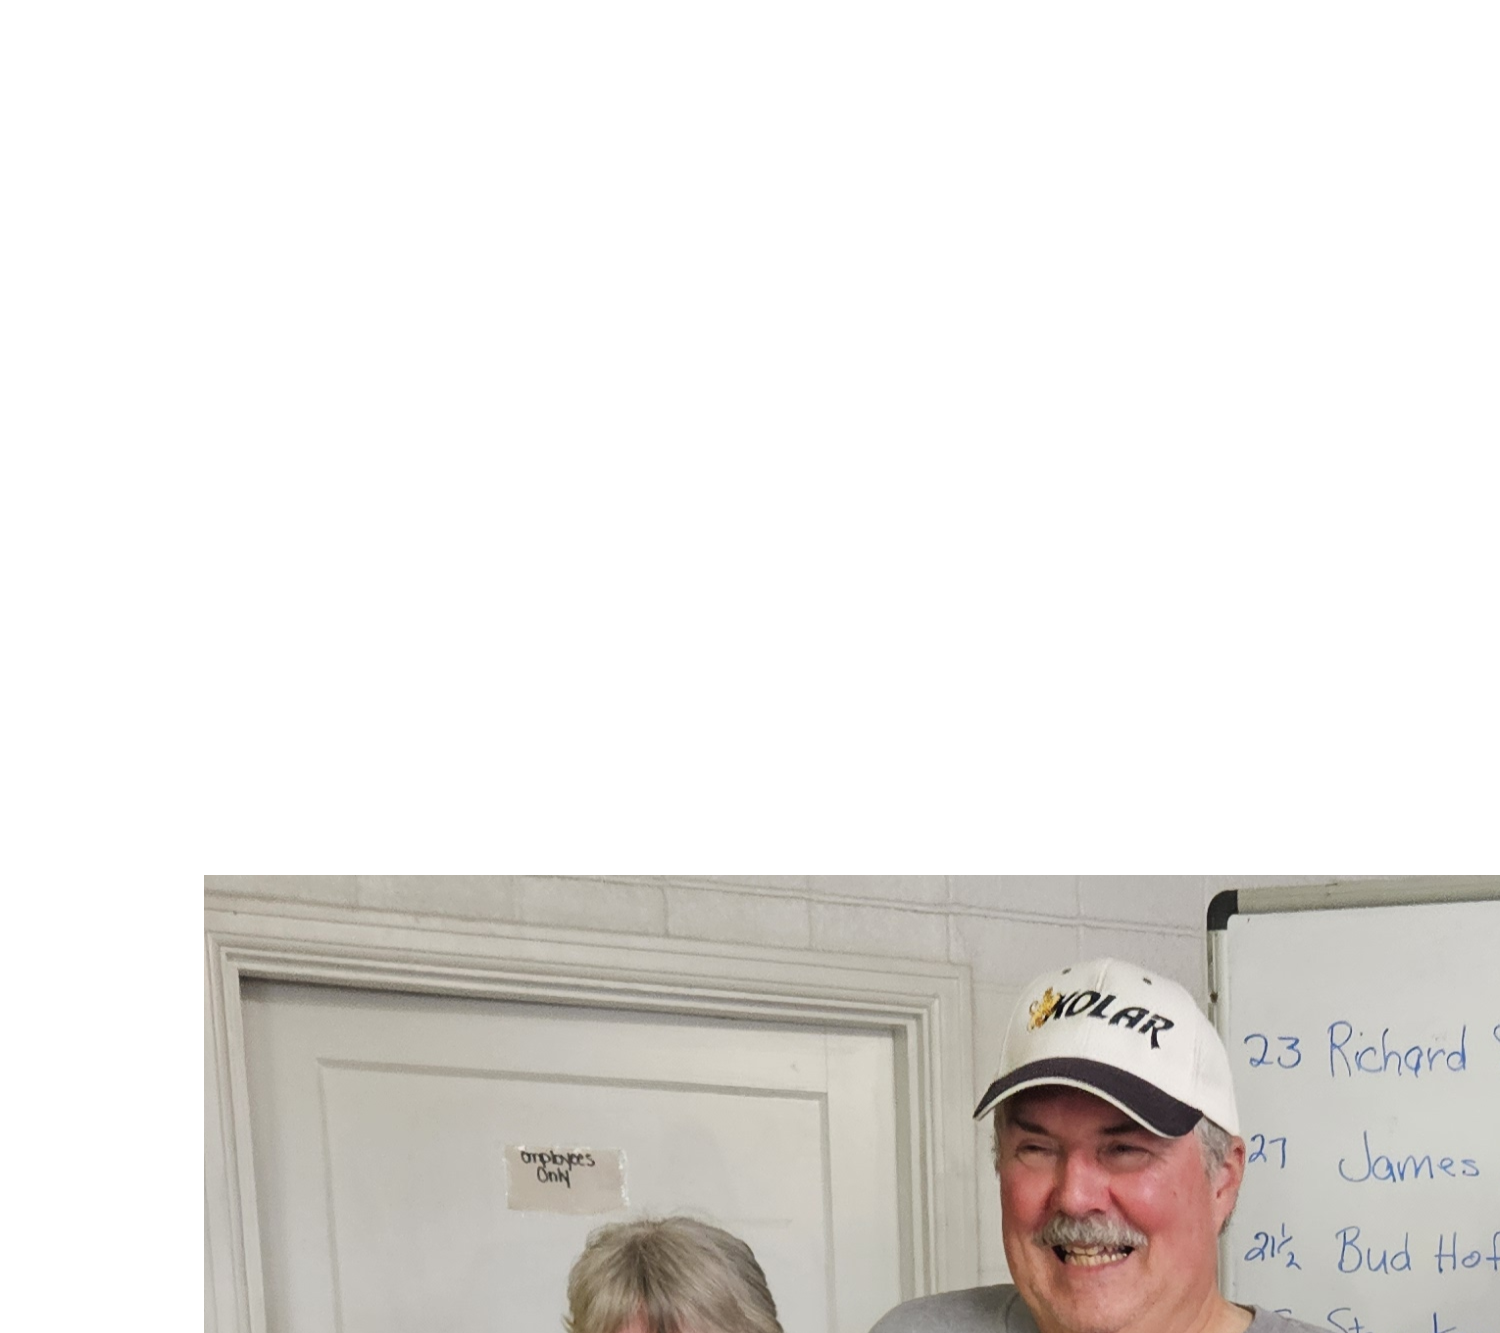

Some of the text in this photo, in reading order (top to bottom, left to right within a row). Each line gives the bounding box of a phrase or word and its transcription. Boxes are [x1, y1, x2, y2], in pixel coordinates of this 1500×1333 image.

[1244, 1033, 1302, 1069] 23
[1326, 1019, 1468, 1077] Richard
[536, 1165, 571, 1189] Only
[1337, 1130, 1480, 1184] James
[1335, 1226, 1412, 1275] Bud
